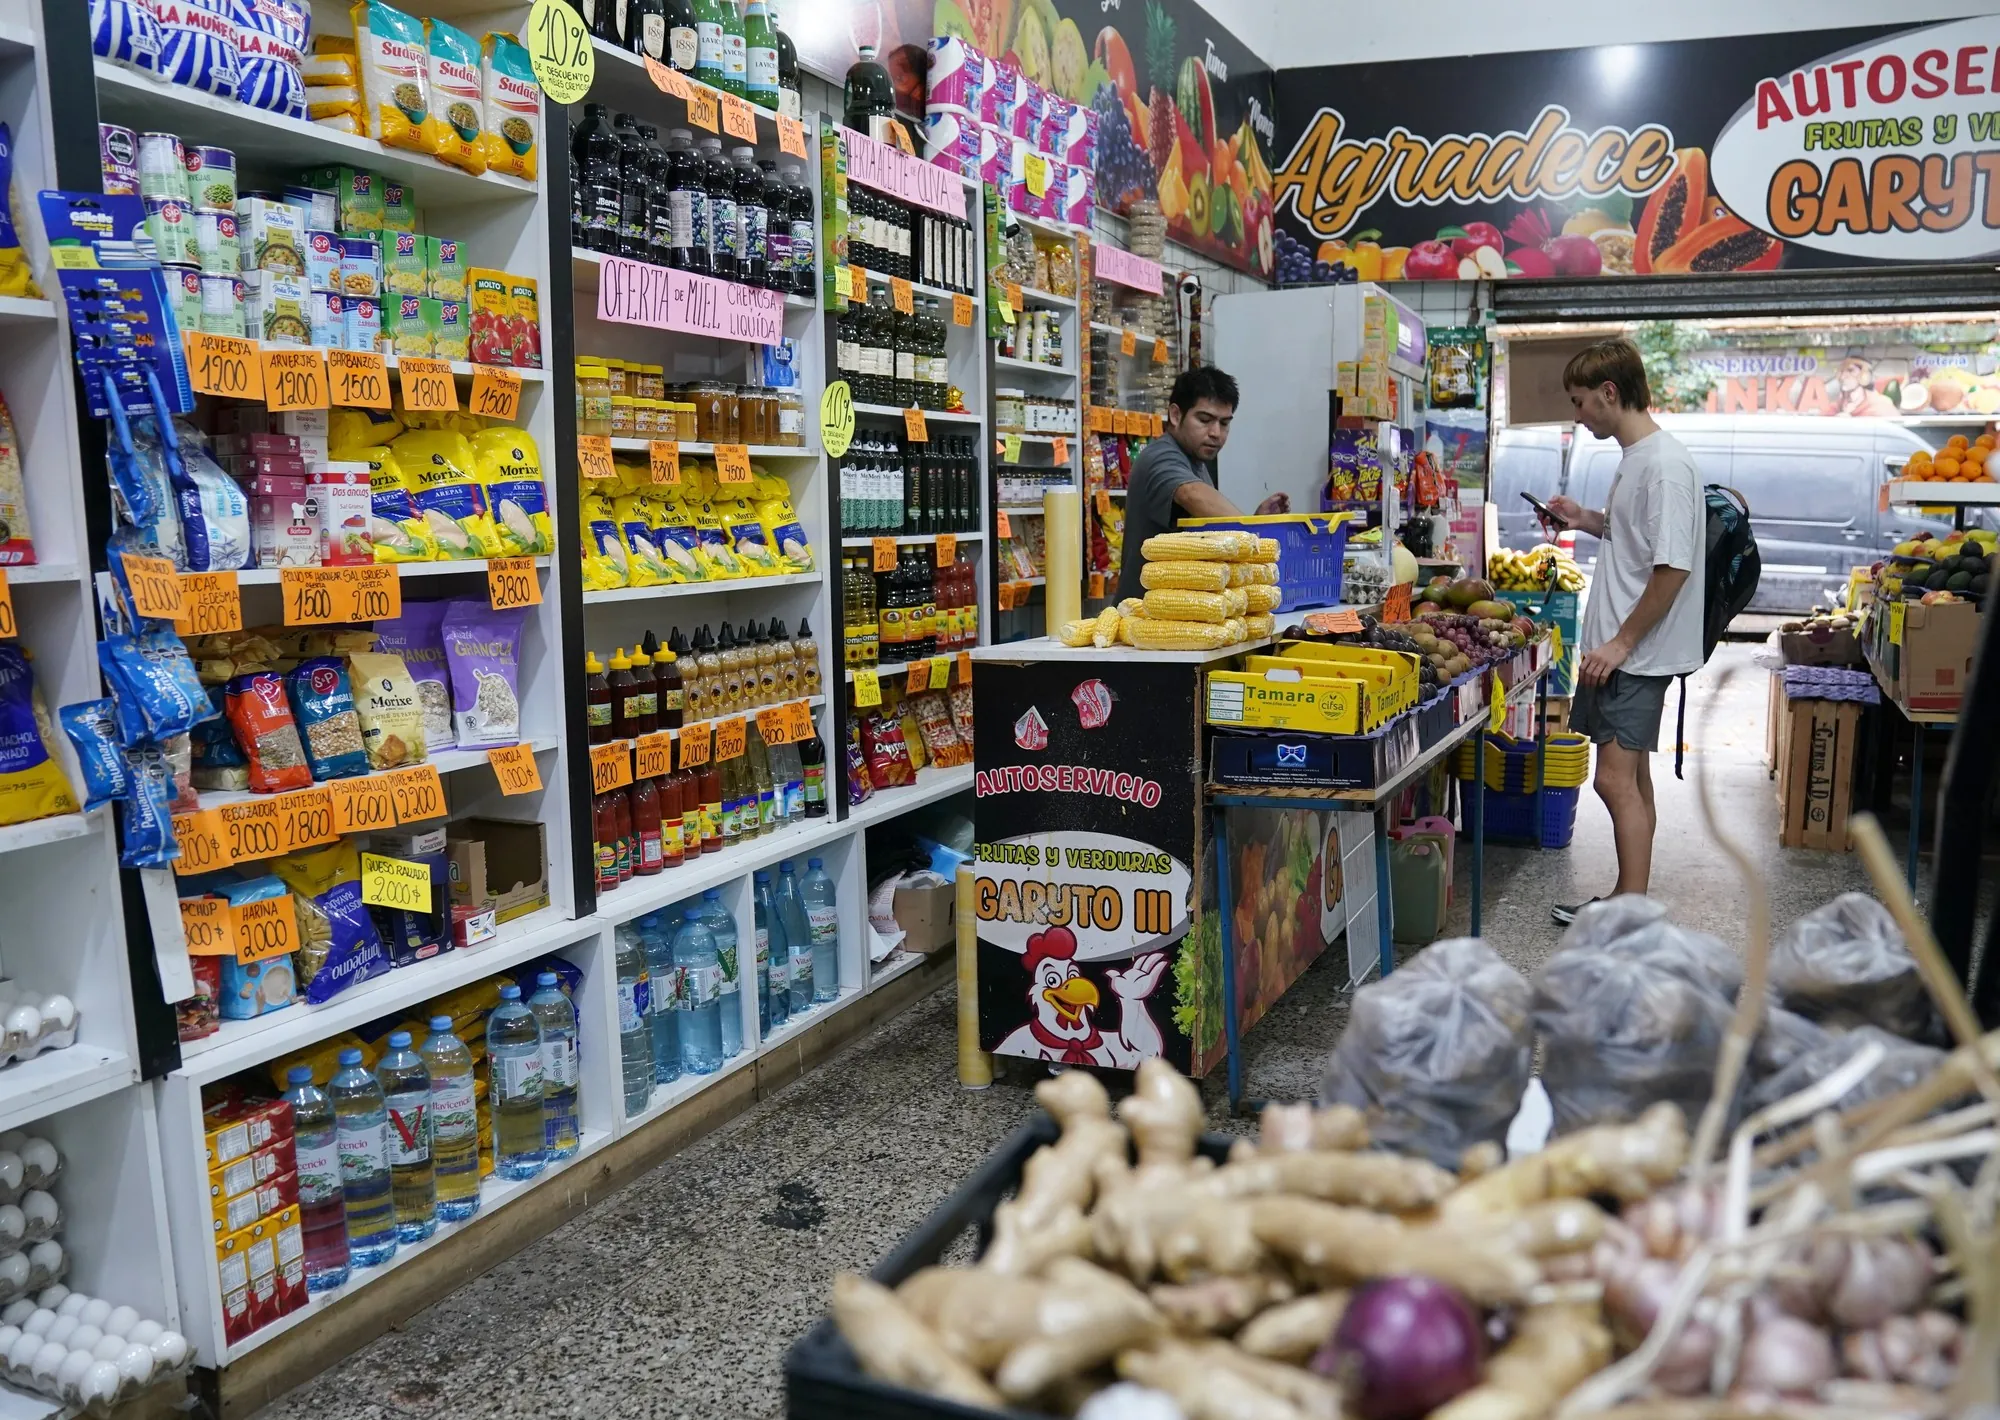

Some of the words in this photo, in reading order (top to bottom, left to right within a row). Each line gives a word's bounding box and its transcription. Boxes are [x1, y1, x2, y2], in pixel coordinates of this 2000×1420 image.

[157, 5, 180, 25] LA
[239, 35, 260, 53] LA
[538, 4, 588, 68] 10%
[675, 39, 695, 50] 1888
[1205, 38, 1228, 83] Tuna
[534, 61, 542, 71] DE
[547, 66, 590, 82] DESCUENTO
[408, 128, 421, 140] 1KG
[1804, 116, 1923, 151] FRUTAS
[1933, 114, 1957, 144] Y
[459, 145, 472, 156] 1KG
[511, 158, 524, 169] 1KG
[1274, 104, 1677, 240] Agradece
[917, 164, 950, 210] OLIVA
[70, 211, 113, 224] Gillette
[478, 281, 501, 290] MOLTO
[514, 288, 532, 297] MOLTO
[604, 260, 669, 322] OFERTA
[675, 288, 684, 302] DE
[727, 283, 777, 311] CREMOSA
[201, 337, 251, 355] ARVERJA
[270, 353, 318, 369] ARVERJAS
[329, 352, 380, 370] GARBANZOS
[200, 355, 247, 392] 1200
[276, 371, 318, 408] 1200
[342, 374, 381, 402] 1500
[412, 375, 446, 407] 1800
[825, 385, 852, 431] 10%
[418, 468, 466, 485] Morixe
[499, 463, 540, 477] Morixe
[1358, 467, 1382, 483] Takis
[332, 488, 346, 496] Dos
[435, 488, 463, 498] AREPAS
[513, 484, 536, 492] AREPAS
[283, 570, 303, 582] POLVO
[343, 569, 360, 581] SAL
[362, 569, 391, 580] GRUESA
[357, 581, 383, 590] OFERTA
[198, 591, 240, 605] LEDESMA
[295, 588, 331, 620] 1500
[454, 642, 512, 658] GRANOLA
[371, 695, 413, 710] Morixe
[1247, 686, 1315, 704] Tamara
[1322, 701, 1344, 711] cifsa
[491, 750, 521, 765] GRANOLA
[875, 742, 906, 755] Doritos
[389, 774, 405, 787] PURE
[415, 769, 433, 782] PAPA
[595, 762, 618, 790] 1800
[332, 779, 387, 797] PISINGALLO
[976, 765, 1161, 809] AUTOSERVICIO
[134, 779, 155, 830] Pehuamar
[221, 802, 278, 822] REBOZADOR
[344, 795, 387, 827] 1600
[285, 810, 330, 846] 1800
[366, 858, 395, 874] QUESO
[974, 843, 1040, 865] FRUTAS
[1046, 846, 1059, 867] Y
[1066, 848, 1172, 874] VERDURAS
[975, 877, 1123, 931] GARYTO
[1134, 889, 1172, 935] III
